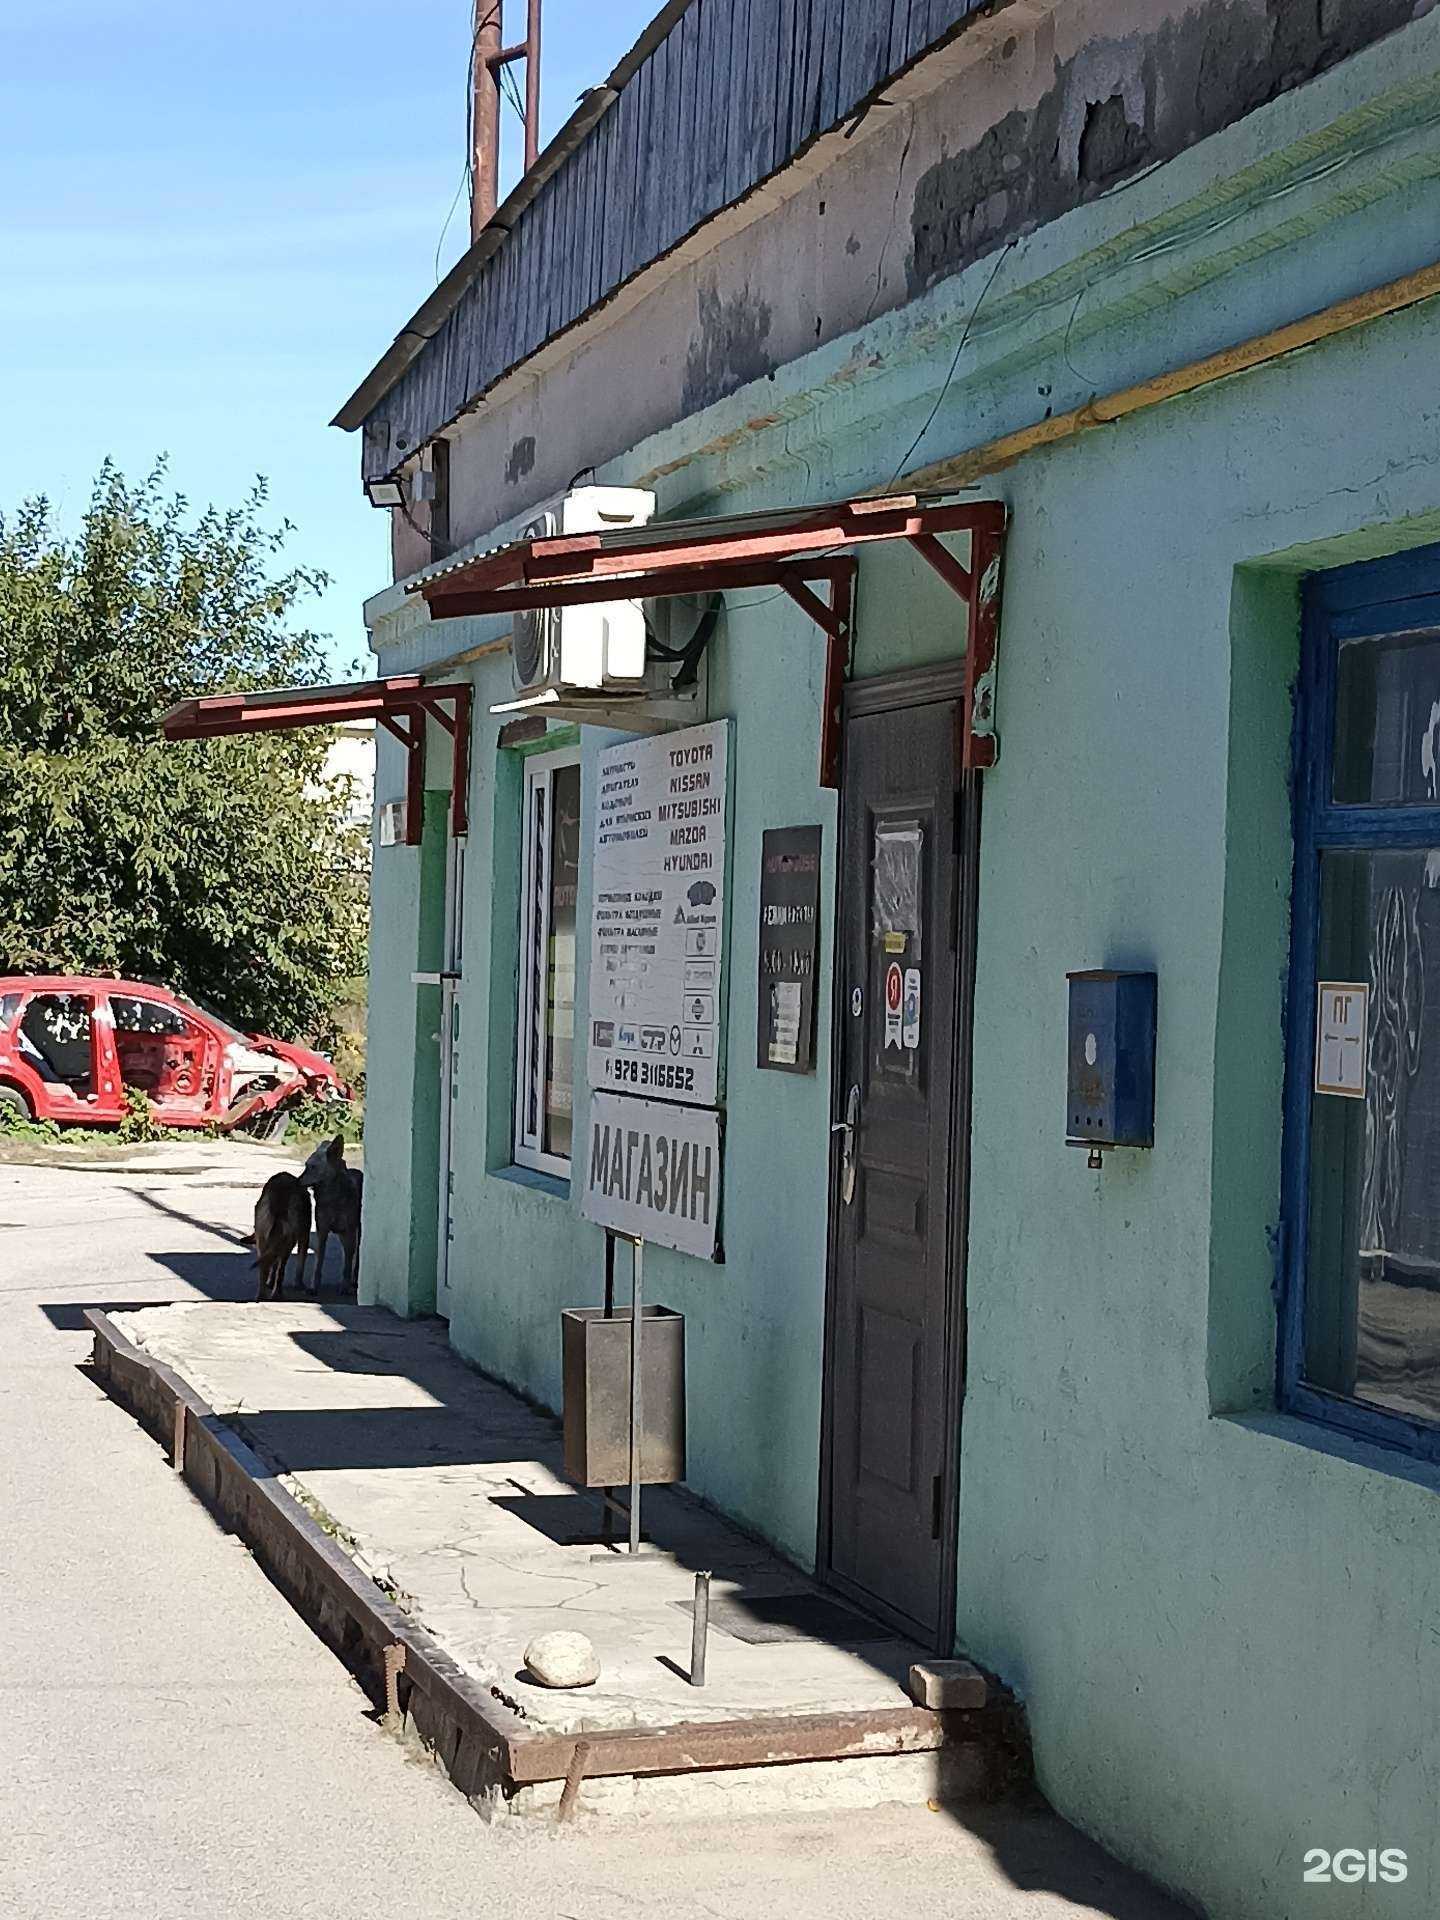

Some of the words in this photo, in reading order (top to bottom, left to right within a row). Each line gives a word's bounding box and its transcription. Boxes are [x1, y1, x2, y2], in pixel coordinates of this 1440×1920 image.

[669, 744, 713, 767] TOYOTA
[669, 772, 710, 793] NISSAN
[658, 798, 721, 822] MITSUBISHI
[669, 825, 706, 845] MAZDA
[663, 853, 712, 872] HYUNDAI
[614, 1058, 638, 1083] 978
[640, 1062, 694, 1091] 3116652
[589, 1123, 712, 1225] МАГАЗИН
